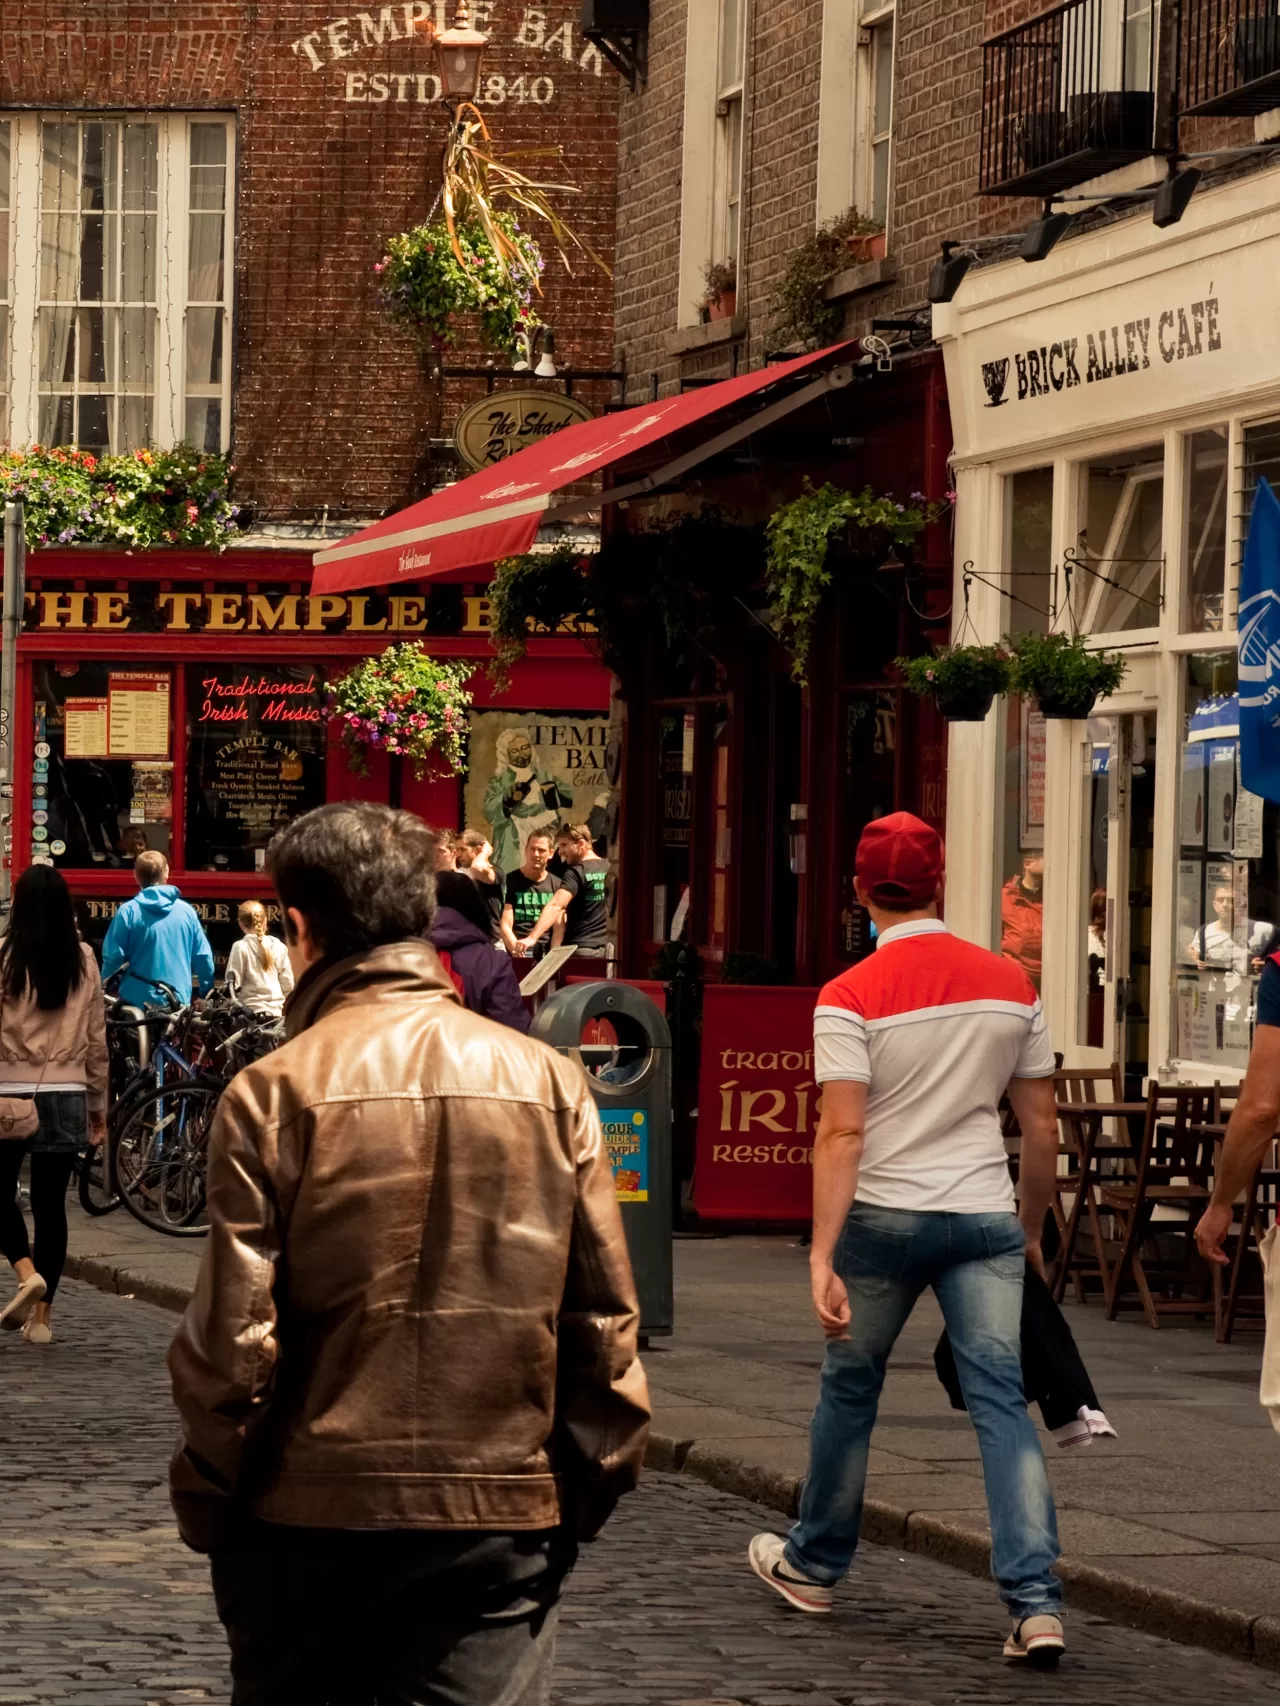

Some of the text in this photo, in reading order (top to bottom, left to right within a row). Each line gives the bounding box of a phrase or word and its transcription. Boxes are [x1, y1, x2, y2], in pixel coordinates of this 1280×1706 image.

[1015, 281, 1221, 400] BRICK ALLEY CAFÉ
[488, 412, 514, 436] The
[158, 593, 429, 631] TEMPLE
[202, 674, 316, 697] Traditional
[199, 700, 320, 721] Irish Music
[216, 737, 298, 760] TEMPLE BAR
[215, 760, 257, 768] Traditional
[260, 760, 278, 768] Food
[87, 901, 118, 918] TH
[605, 1135, 629, 1144] UIDE
[606, 1145, 640, 1155] EMPLE
